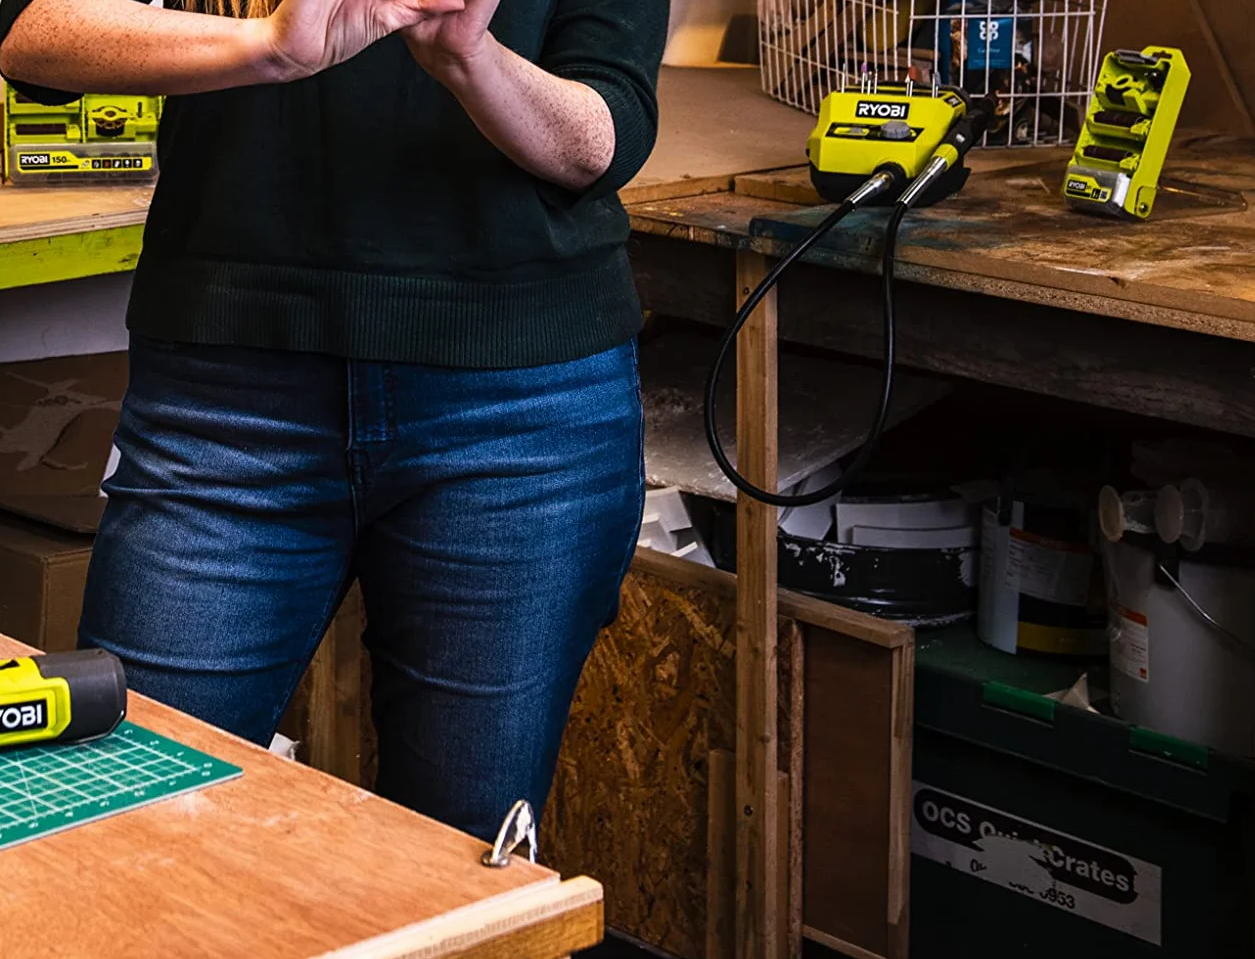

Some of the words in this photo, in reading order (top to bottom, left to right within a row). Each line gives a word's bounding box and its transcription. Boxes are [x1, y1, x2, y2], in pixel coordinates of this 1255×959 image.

[858, 103, 907, 117] RYOBI
[21, 155, 49, 165] RYOBI
[922, 801, 972, 835] OCS
